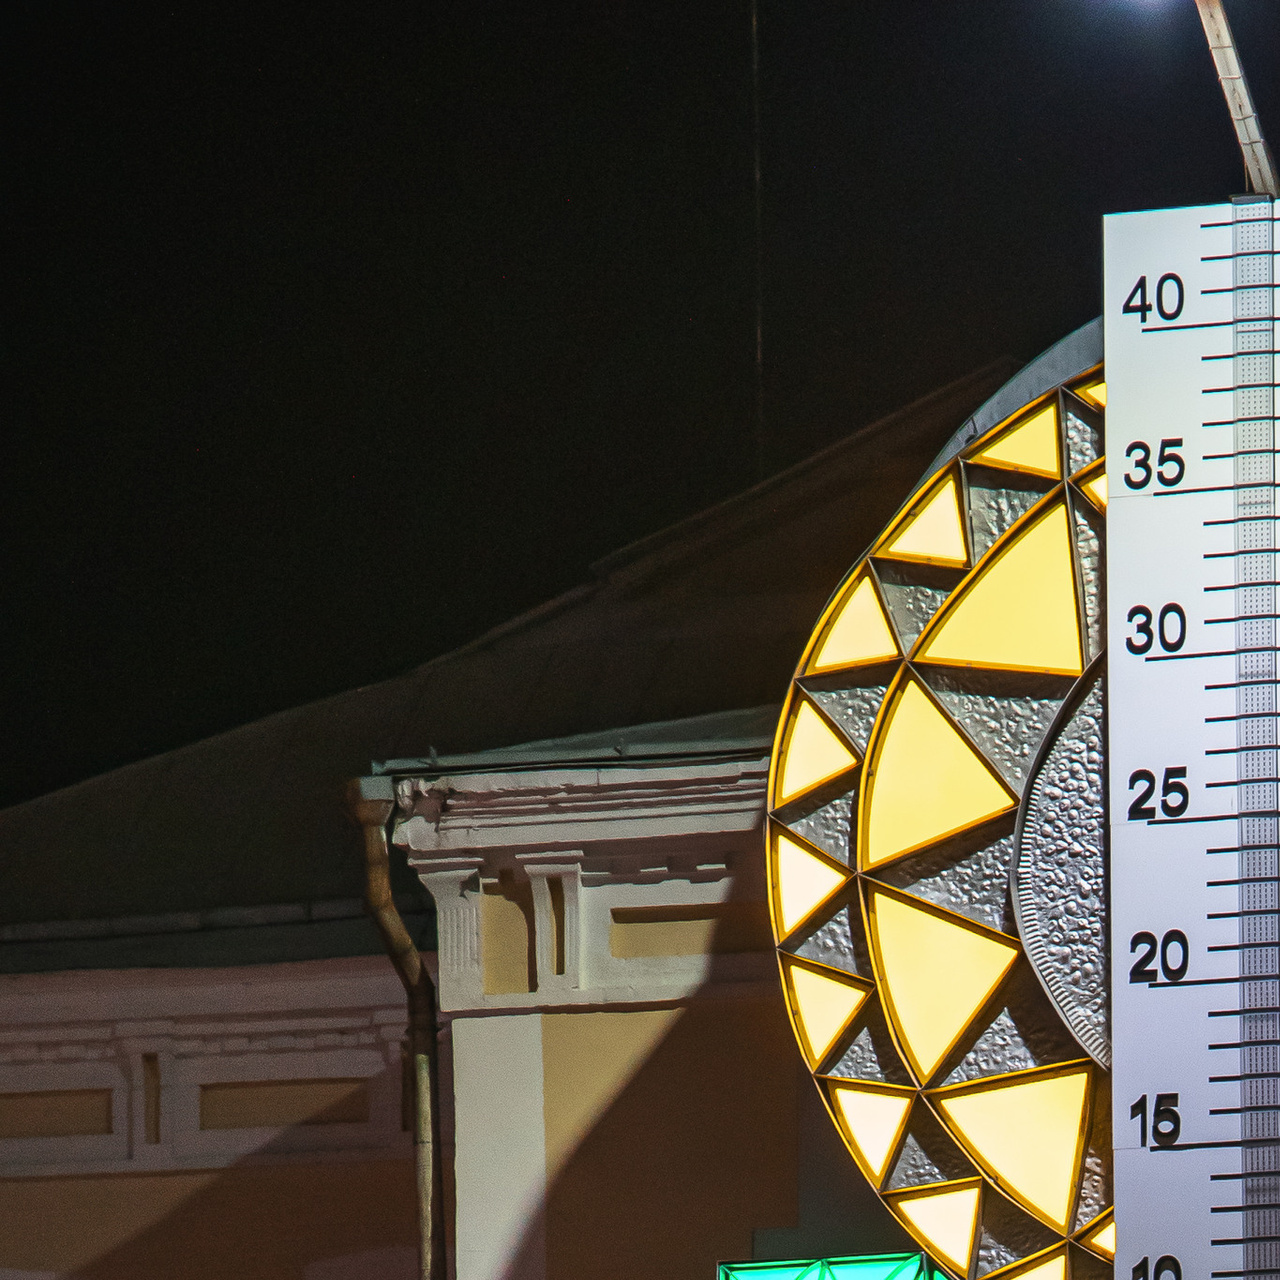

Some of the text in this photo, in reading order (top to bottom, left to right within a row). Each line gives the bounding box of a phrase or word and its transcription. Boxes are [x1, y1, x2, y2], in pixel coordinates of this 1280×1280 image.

[1122, 273, 1184, 323] 40
[1124, 438, 1185, 490] 35
[1125, 602, 1187, 655] 30
[1127, 766, 1189, 820] 25
[1129, 929, 1189, 982] 20
[1130, 1093, 1180, 1147] 15
